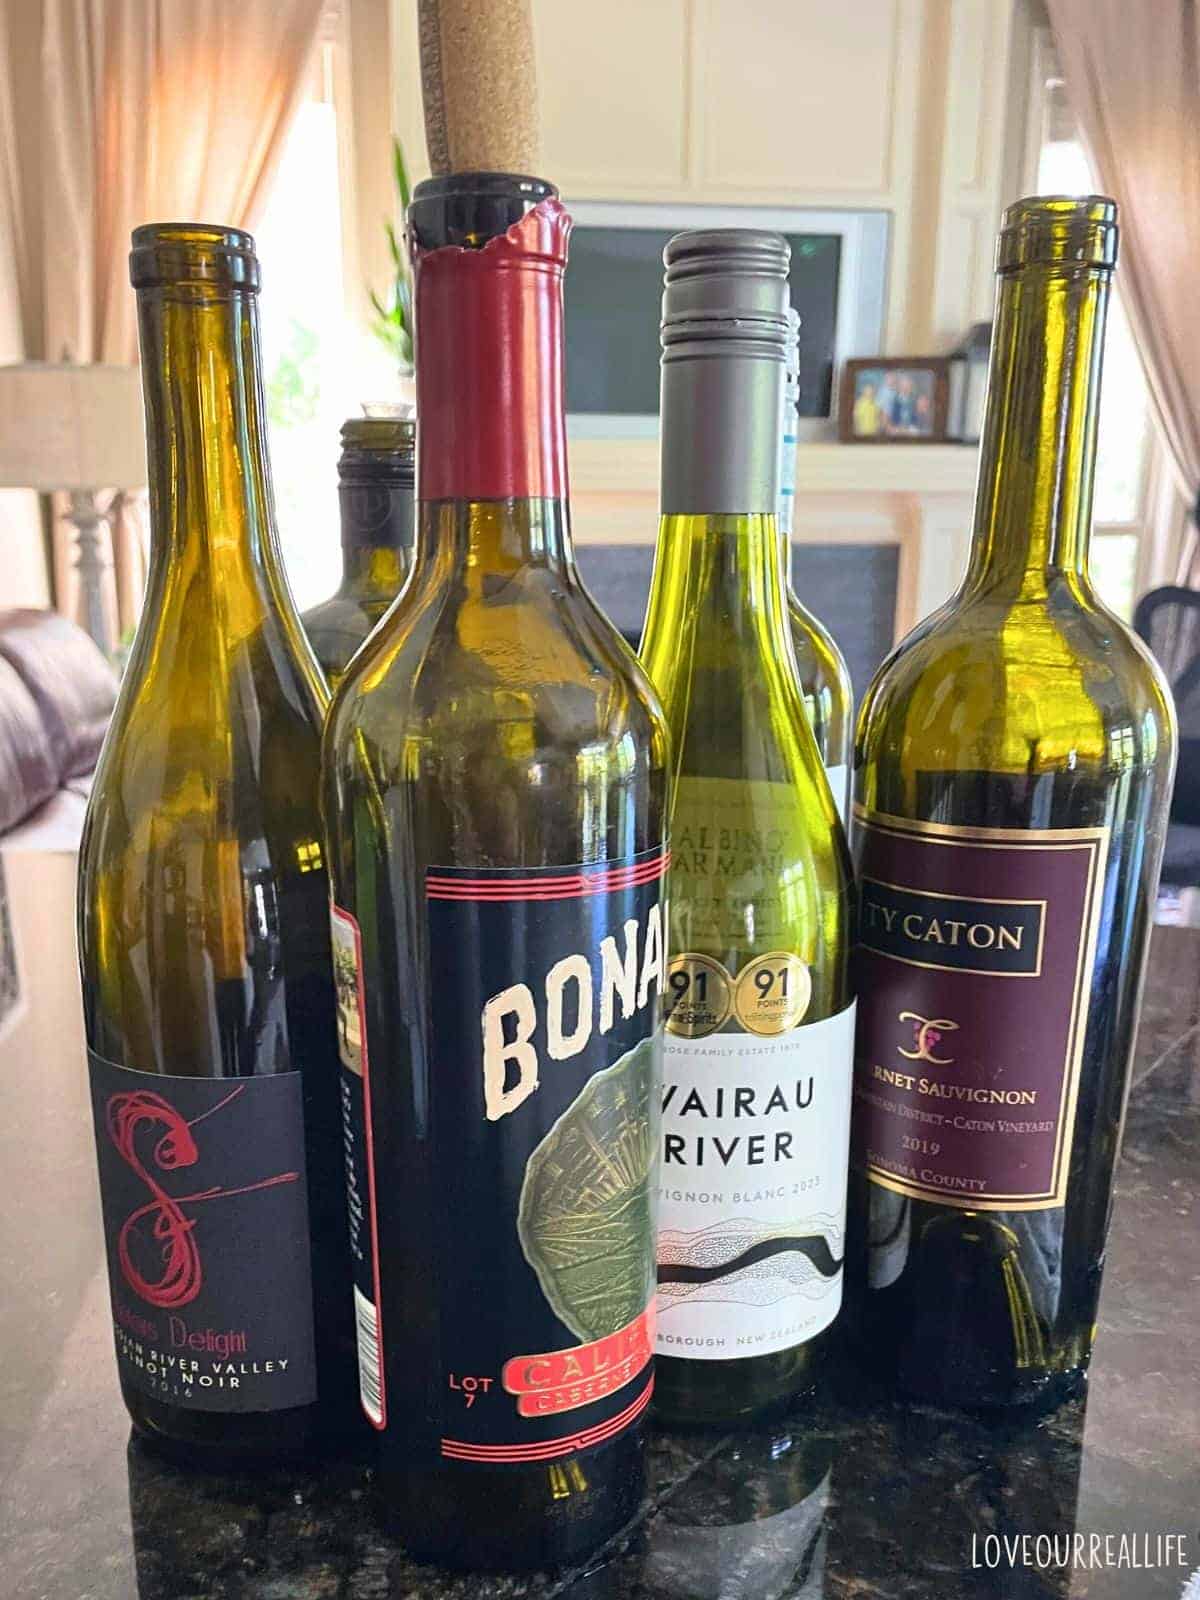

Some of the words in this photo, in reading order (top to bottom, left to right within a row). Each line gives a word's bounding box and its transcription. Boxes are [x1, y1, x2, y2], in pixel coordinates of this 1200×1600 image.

[903, 914, 1025, 951] CATON
[669, 970, 708, 1003] 91
[754, 967, 789, 999] 91
[482, 898, 669, 1121] BONA
[918, 1078, 1037, 1105] SAUVIGNON
[664, 1131, 794, 1167] RIVER
[901, 1135, 941, 1156] 2019
[920, 1168, 988, 1192] COUNTY
[732, 1187, 785, 1204] BLANC
[168, 1314, 248, 1360] Delight
[736, 1334, 767, 1345] NEW
[151, 1350, 200, 1373] RIVER
[212, 1358, 289, 1375] VALLEY
[150, 1376, 193, 1399] 2016
[182, 1372, 241, 1389] NOIR
[449, 1373, 493, 1393] LOT
[464, 1393, 475, 1409] 7
